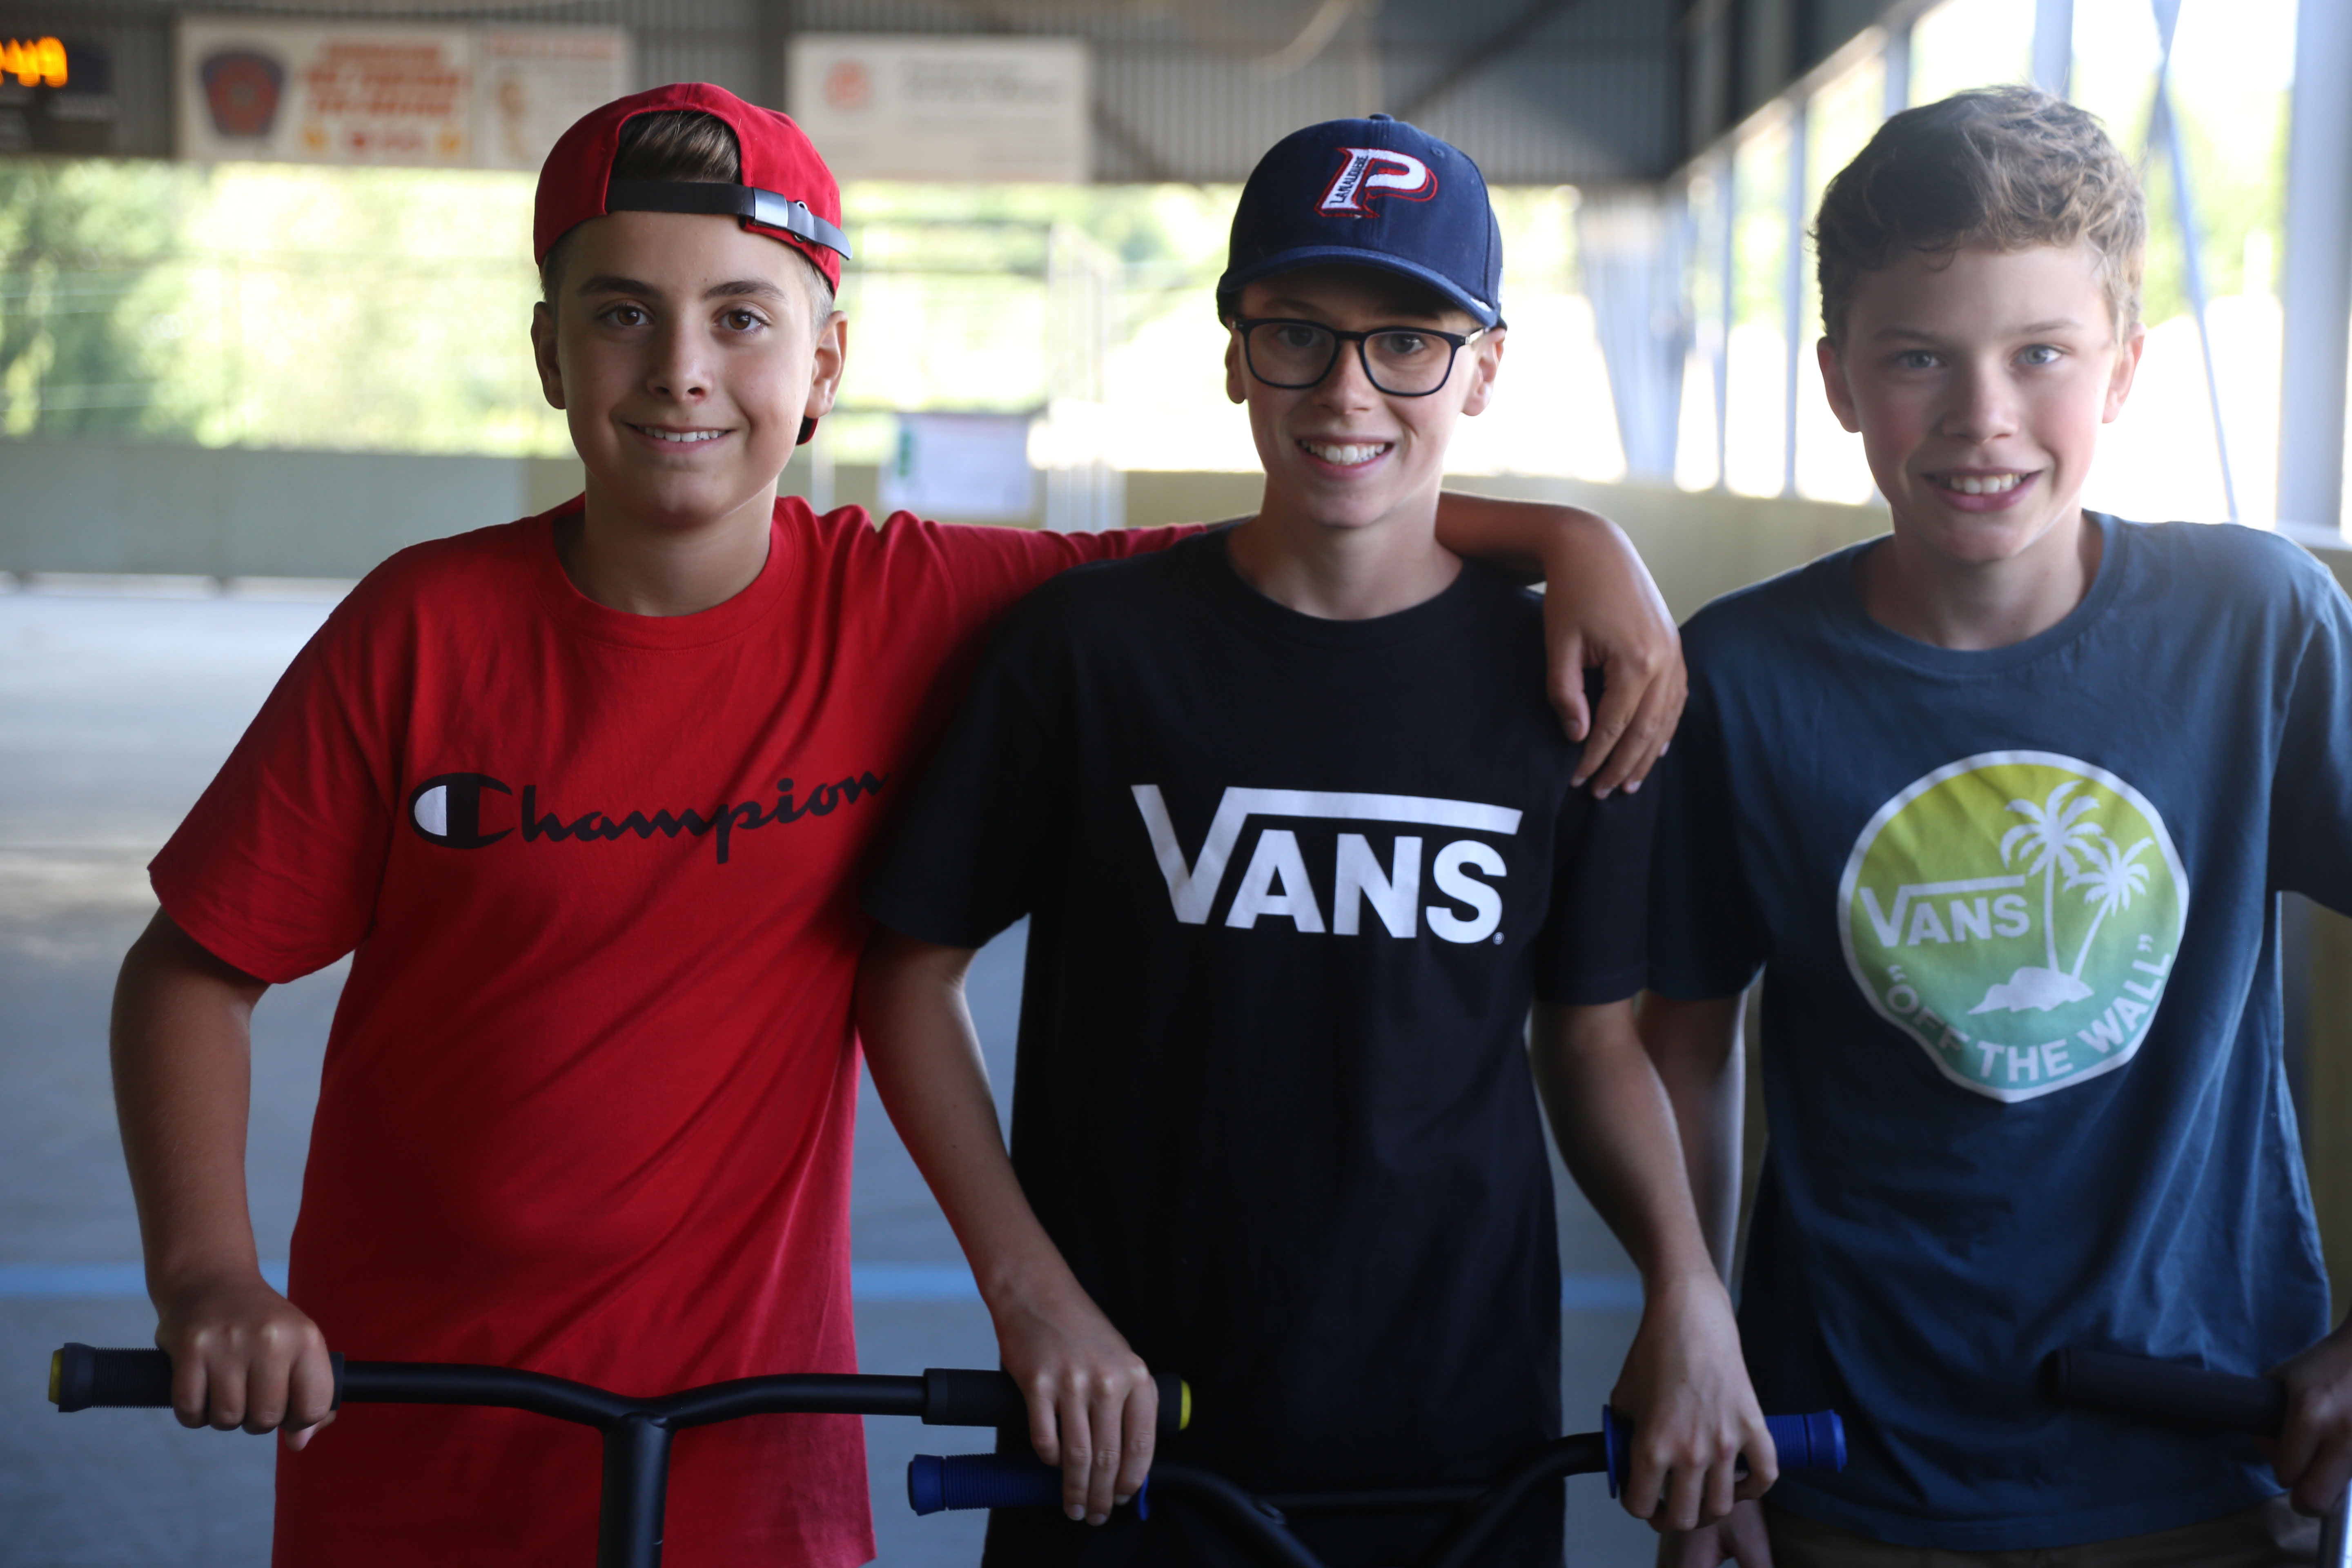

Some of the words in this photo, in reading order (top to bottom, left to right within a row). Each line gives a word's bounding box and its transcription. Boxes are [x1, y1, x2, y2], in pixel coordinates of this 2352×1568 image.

[1314, 147, 1438, 218] P
[408, 770, 891, 864] Champion
[1130, 784, 1523, 944] VANS
[1859, 874, 2031, 947] VANS
[1976, 1038, 2074, 1082] THE
